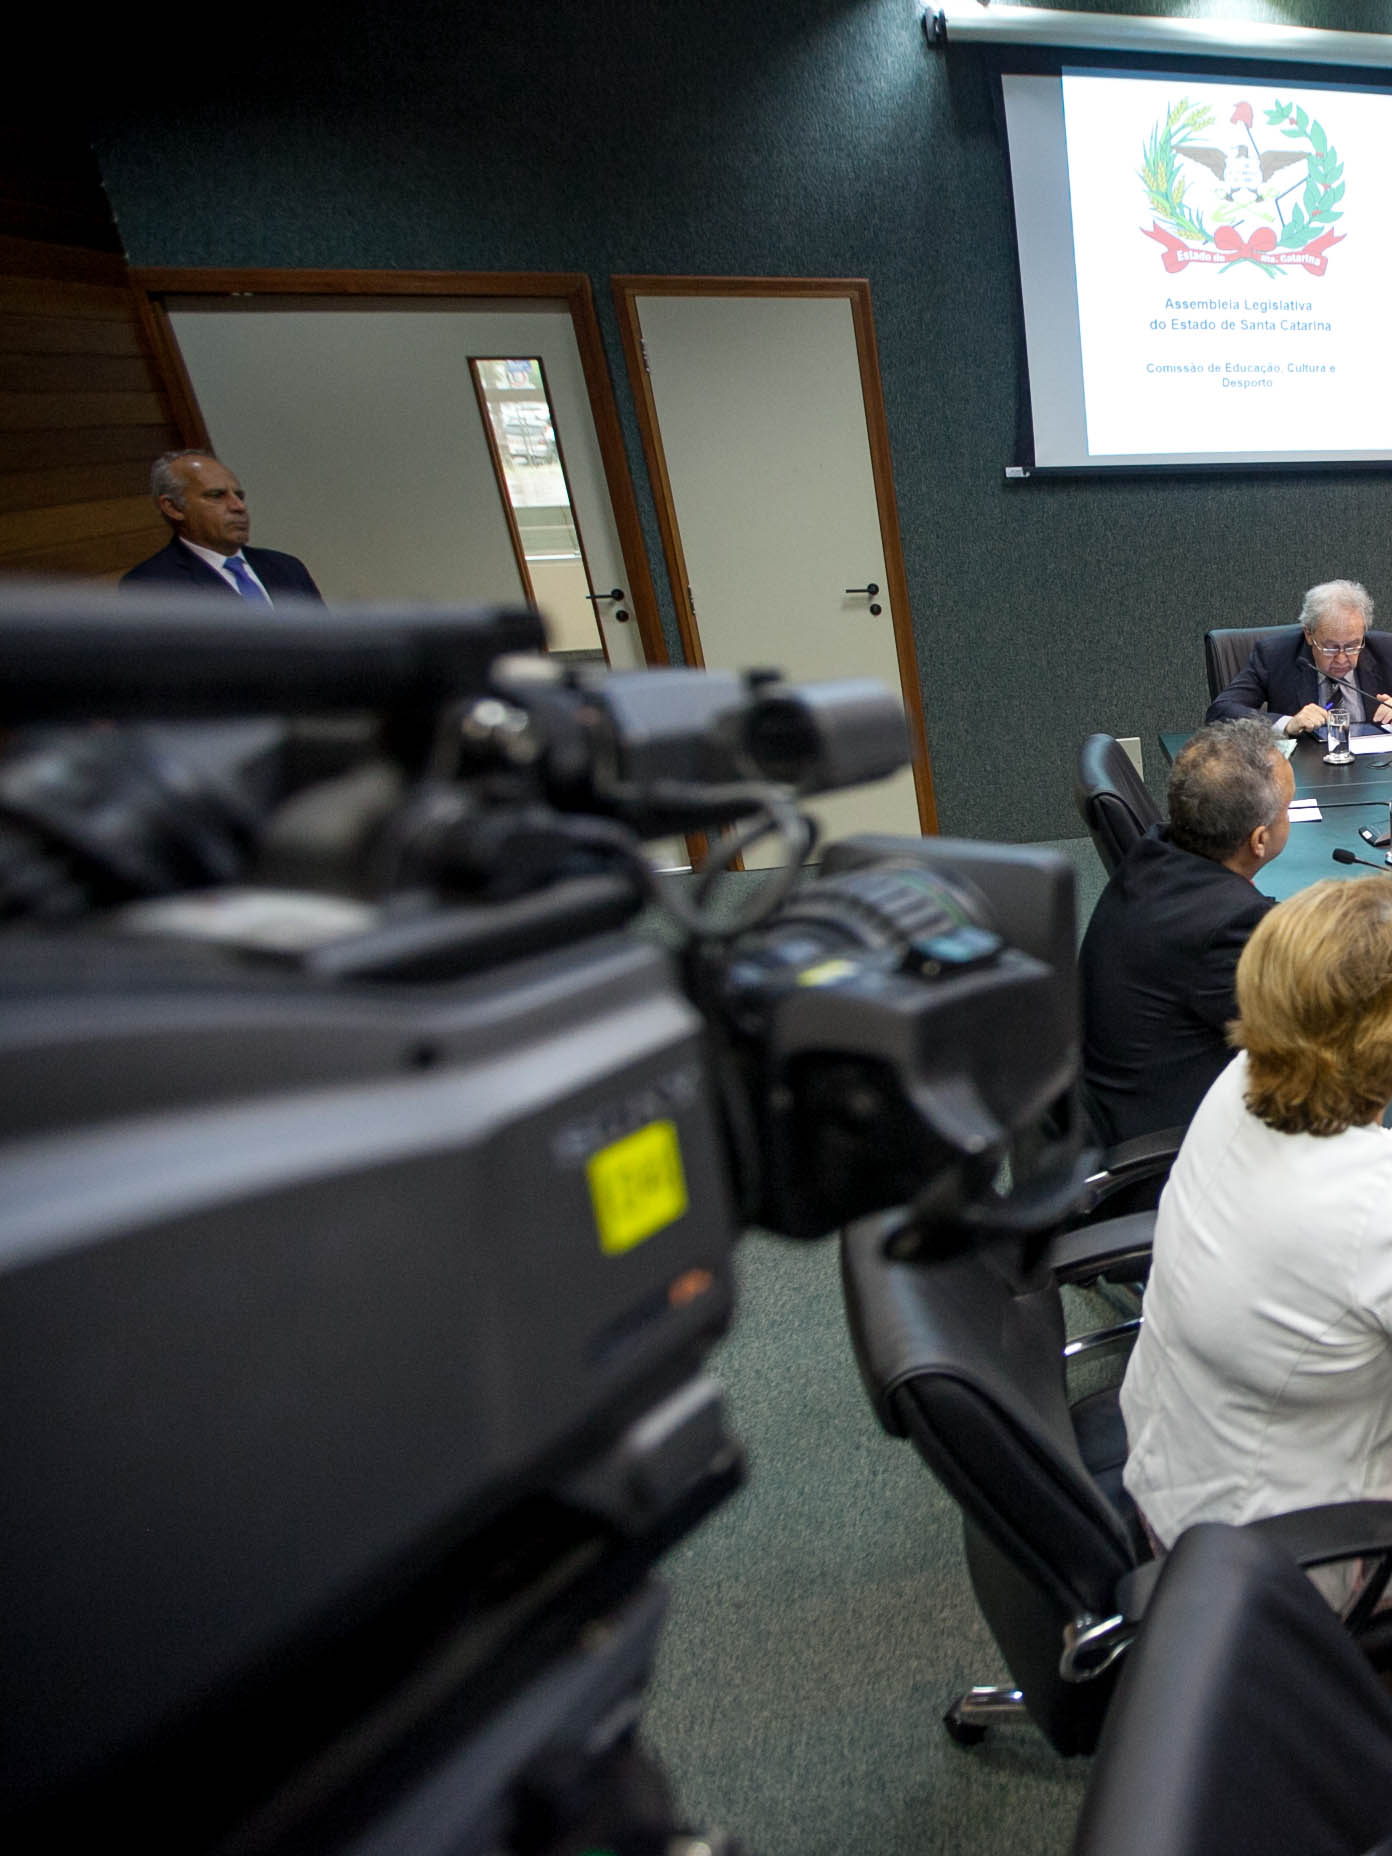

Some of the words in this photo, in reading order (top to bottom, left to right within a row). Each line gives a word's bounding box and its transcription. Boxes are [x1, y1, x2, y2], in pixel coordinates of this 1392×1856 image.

[1165, 297, 1240, 312] Assembleia
[1244, 298, 1313, 314] Legislativa
[1149, 319, 1167, 330] do
[1171, 318, 1216, 331] Estado
[1221, 319, 1236, 331] de
[1240, 319, 1276, 331] Santa
[1280, 319, 1332, 332] Catarina
[1146, 362, 1204, 373] Comissão
[1208, 362, 1221, 373] de
[1287, 363, 1326, 373] Cultura
[1329, 365, 1336, 373] e
[1222, 377, 1273, 389] Desporto
